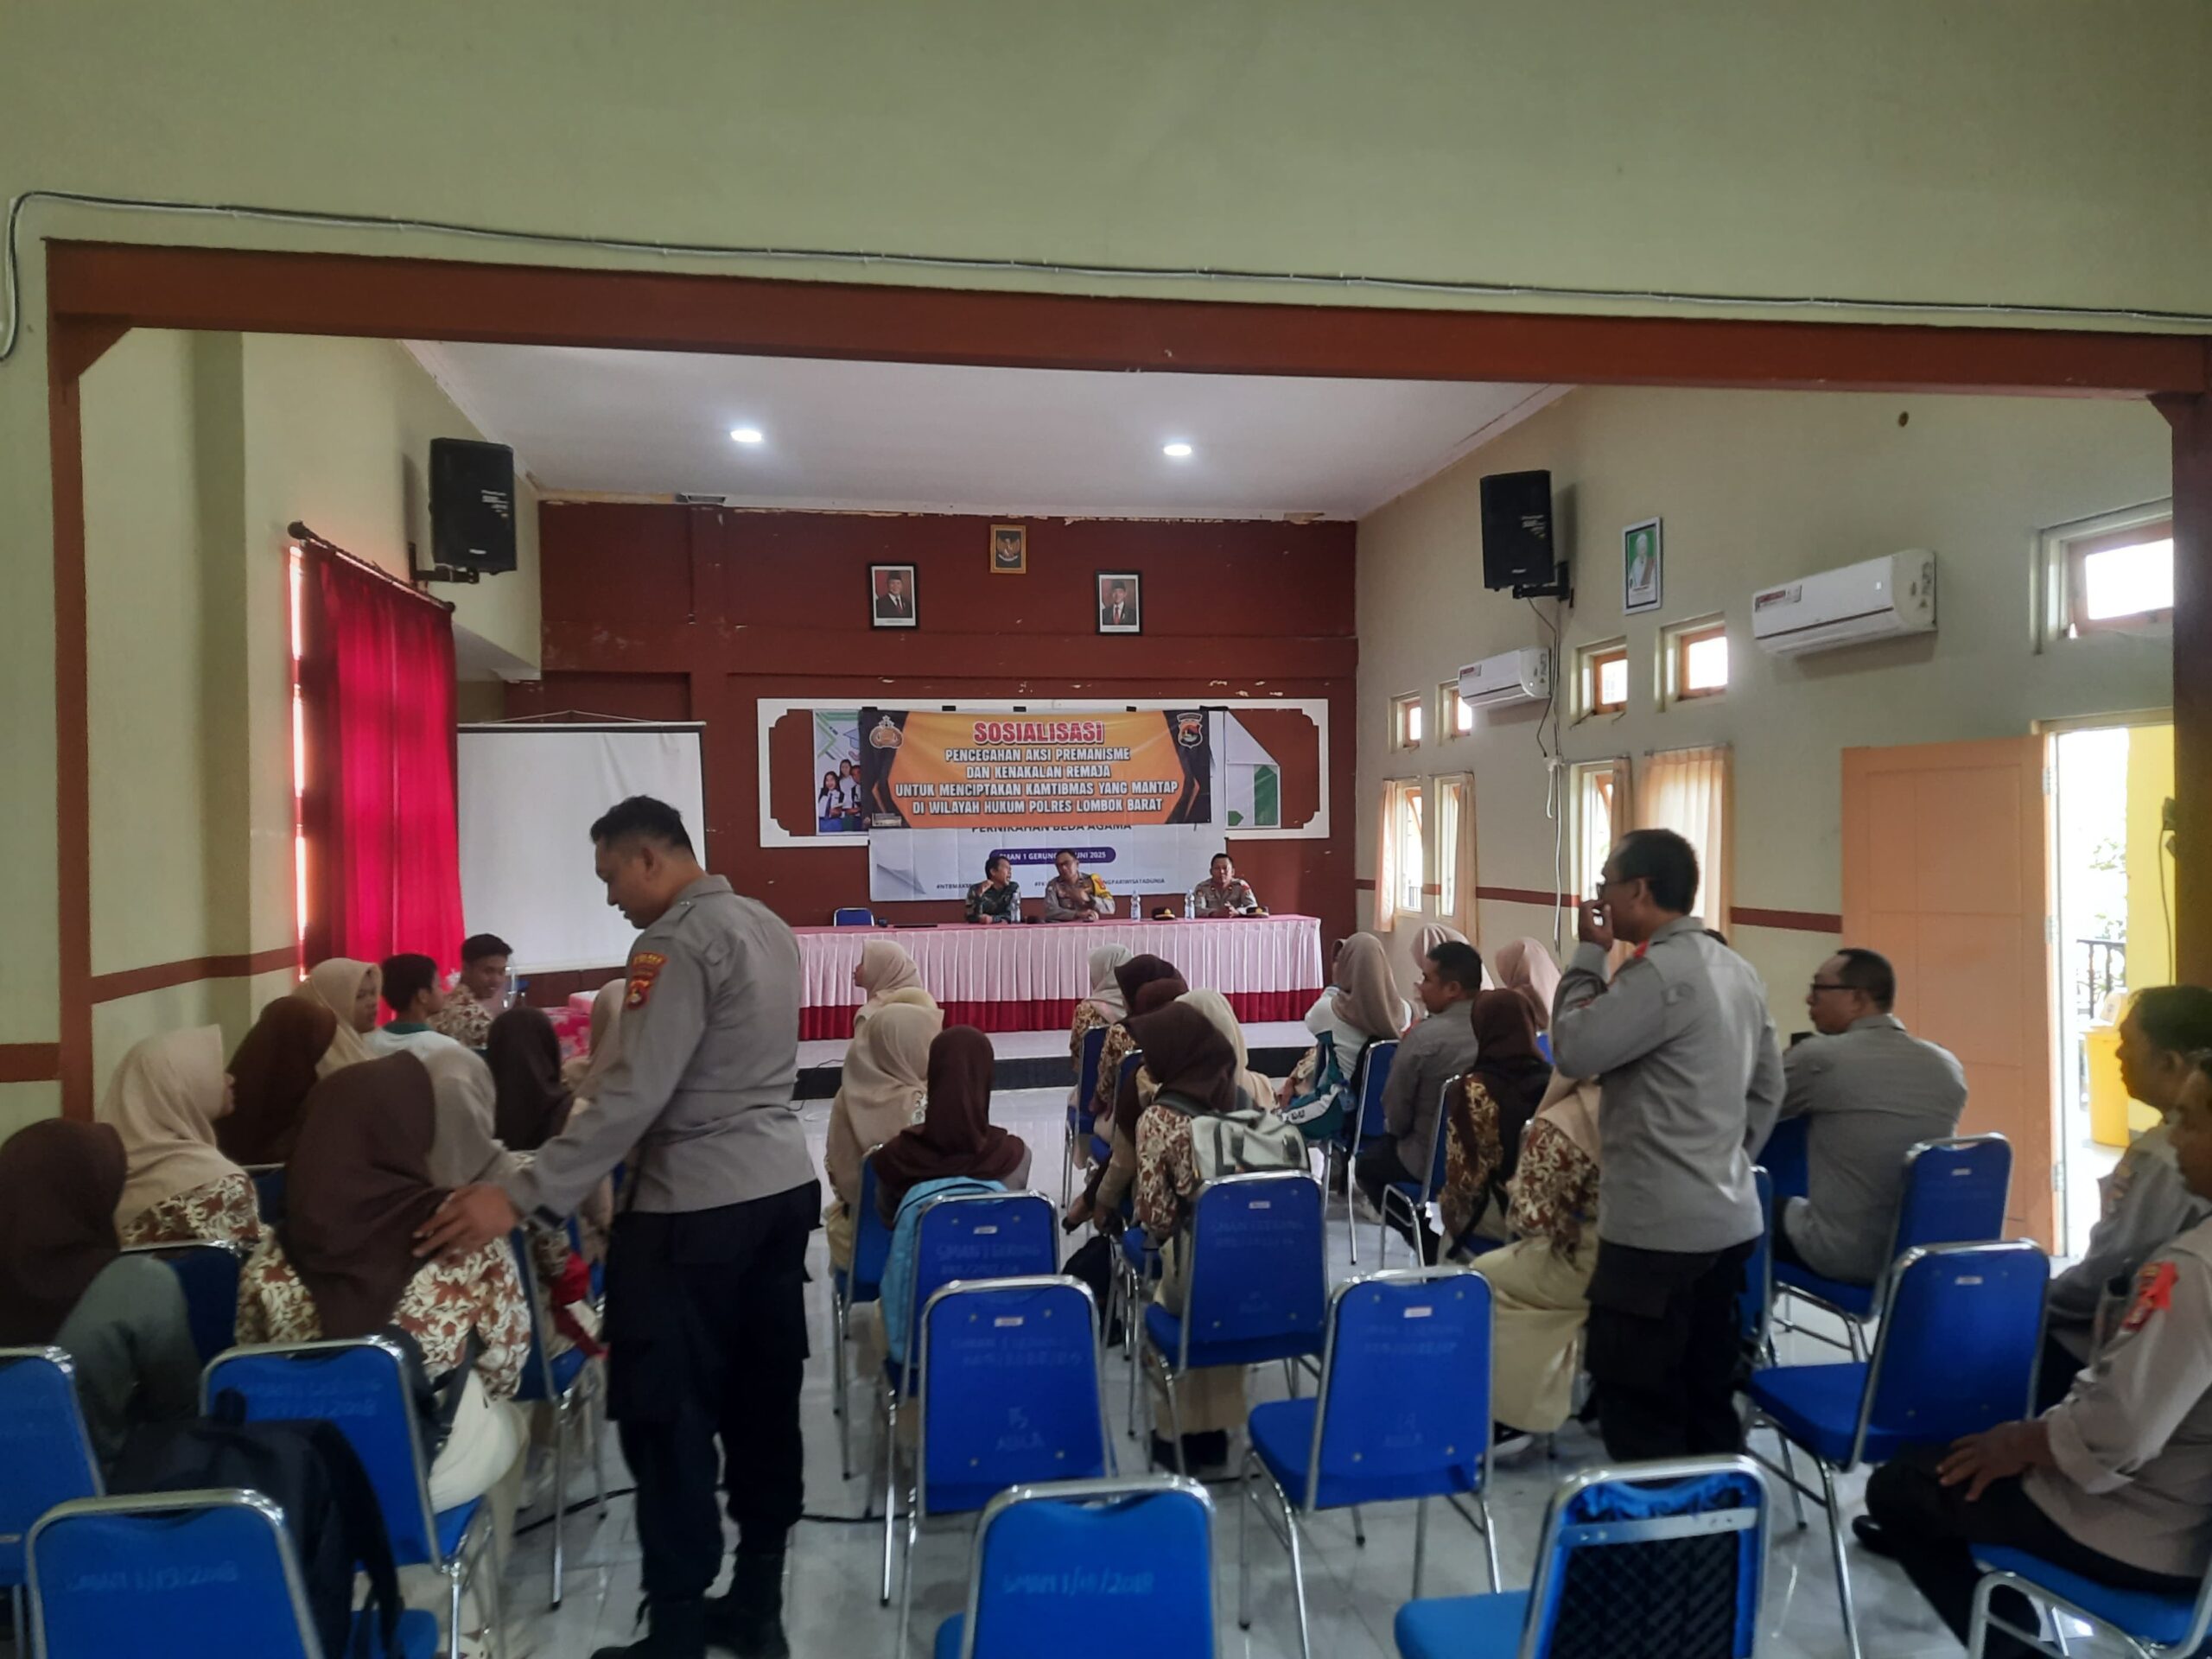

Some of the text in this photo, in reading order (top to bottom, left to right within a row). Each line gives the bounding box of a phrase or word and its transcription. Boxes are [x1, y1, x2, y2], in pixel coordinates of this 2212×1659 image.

[974, 722, 1103, 744] SOSIALISASI
[945, 747, 1130, 762] PENCEGAHAN AKSI PREMANISME
[966, 765, 1111, 779] DAN KENAKALAN REMAJA
[895, 780, 1179, 797] UNTUK MENCIPTAKAN KAMTIBMAS YANG MANTAP
[912, 798, 1163, 814] DI WILAYAH HUKUM POLRES LOMBOK BARAT
